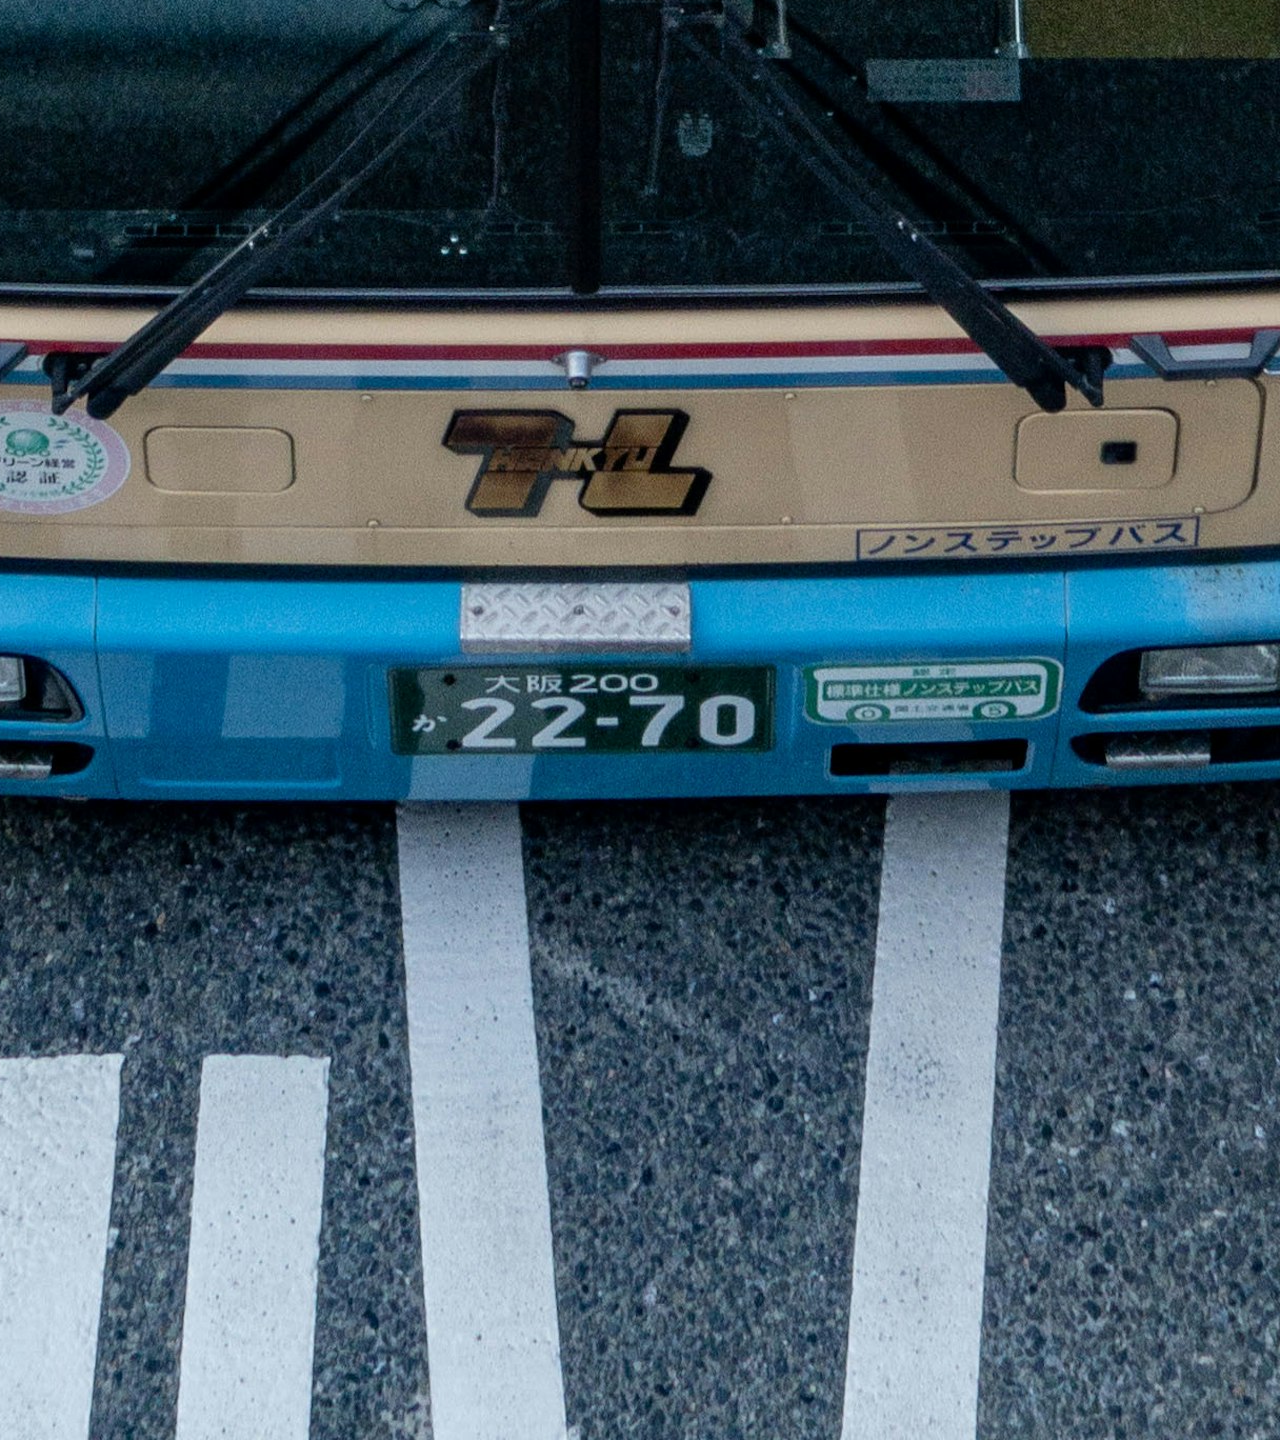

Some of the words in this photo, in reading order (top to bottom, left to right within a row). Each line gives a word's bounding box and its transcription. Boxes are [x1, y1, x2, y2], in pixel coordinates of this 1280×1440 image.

[866, 520, 1187, 556] ノンステップバス
[825, 679, 1040, 700] 標準仕様ノンステップバス
[411, 713, 447, 733] か
[460, 695, 756, 748] 22-70
